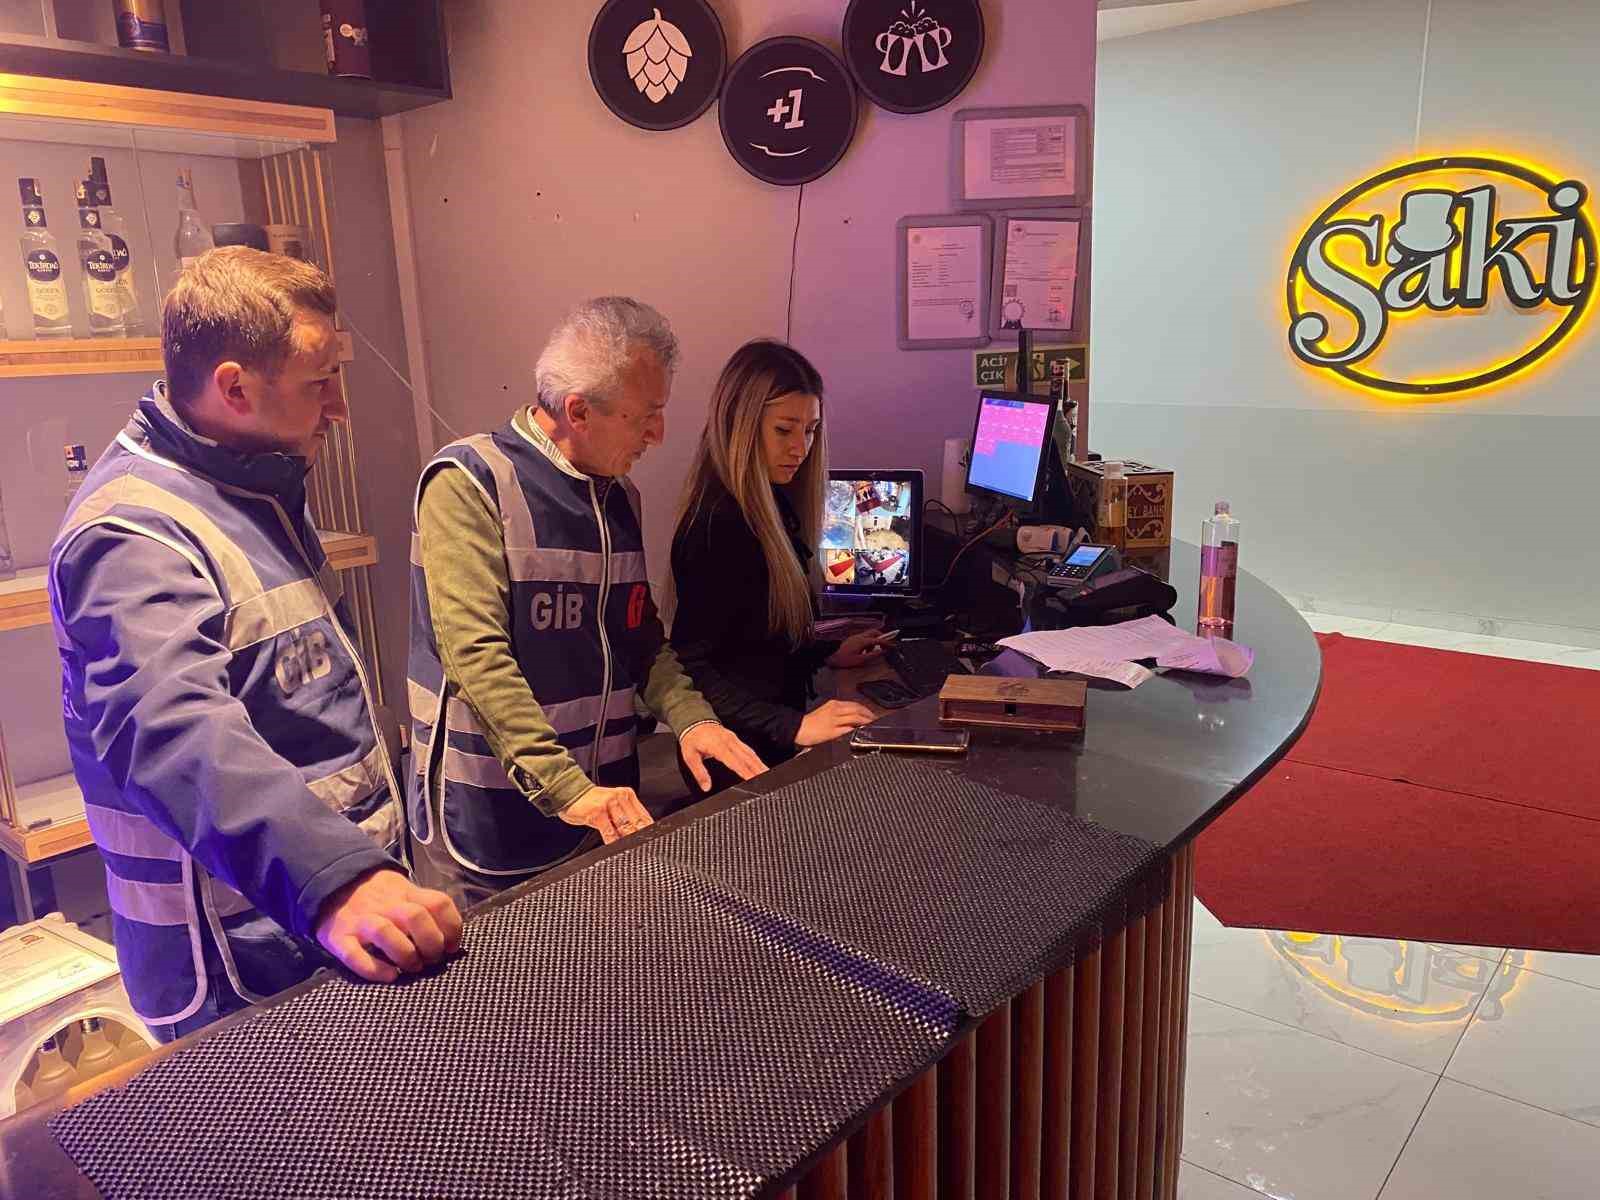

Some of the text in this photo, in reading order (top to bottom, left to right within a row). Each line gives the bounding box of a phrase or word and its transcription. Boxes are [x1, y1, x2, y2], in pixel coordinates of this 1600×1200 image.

[767, 88, 804, 129] +1
[1289, 180, 1588, 368] Saki
[980, 370, 1004, 382] ÇIK
[530, 583, 583, 631] GİB
[275, 627, 333, 696] GİB
